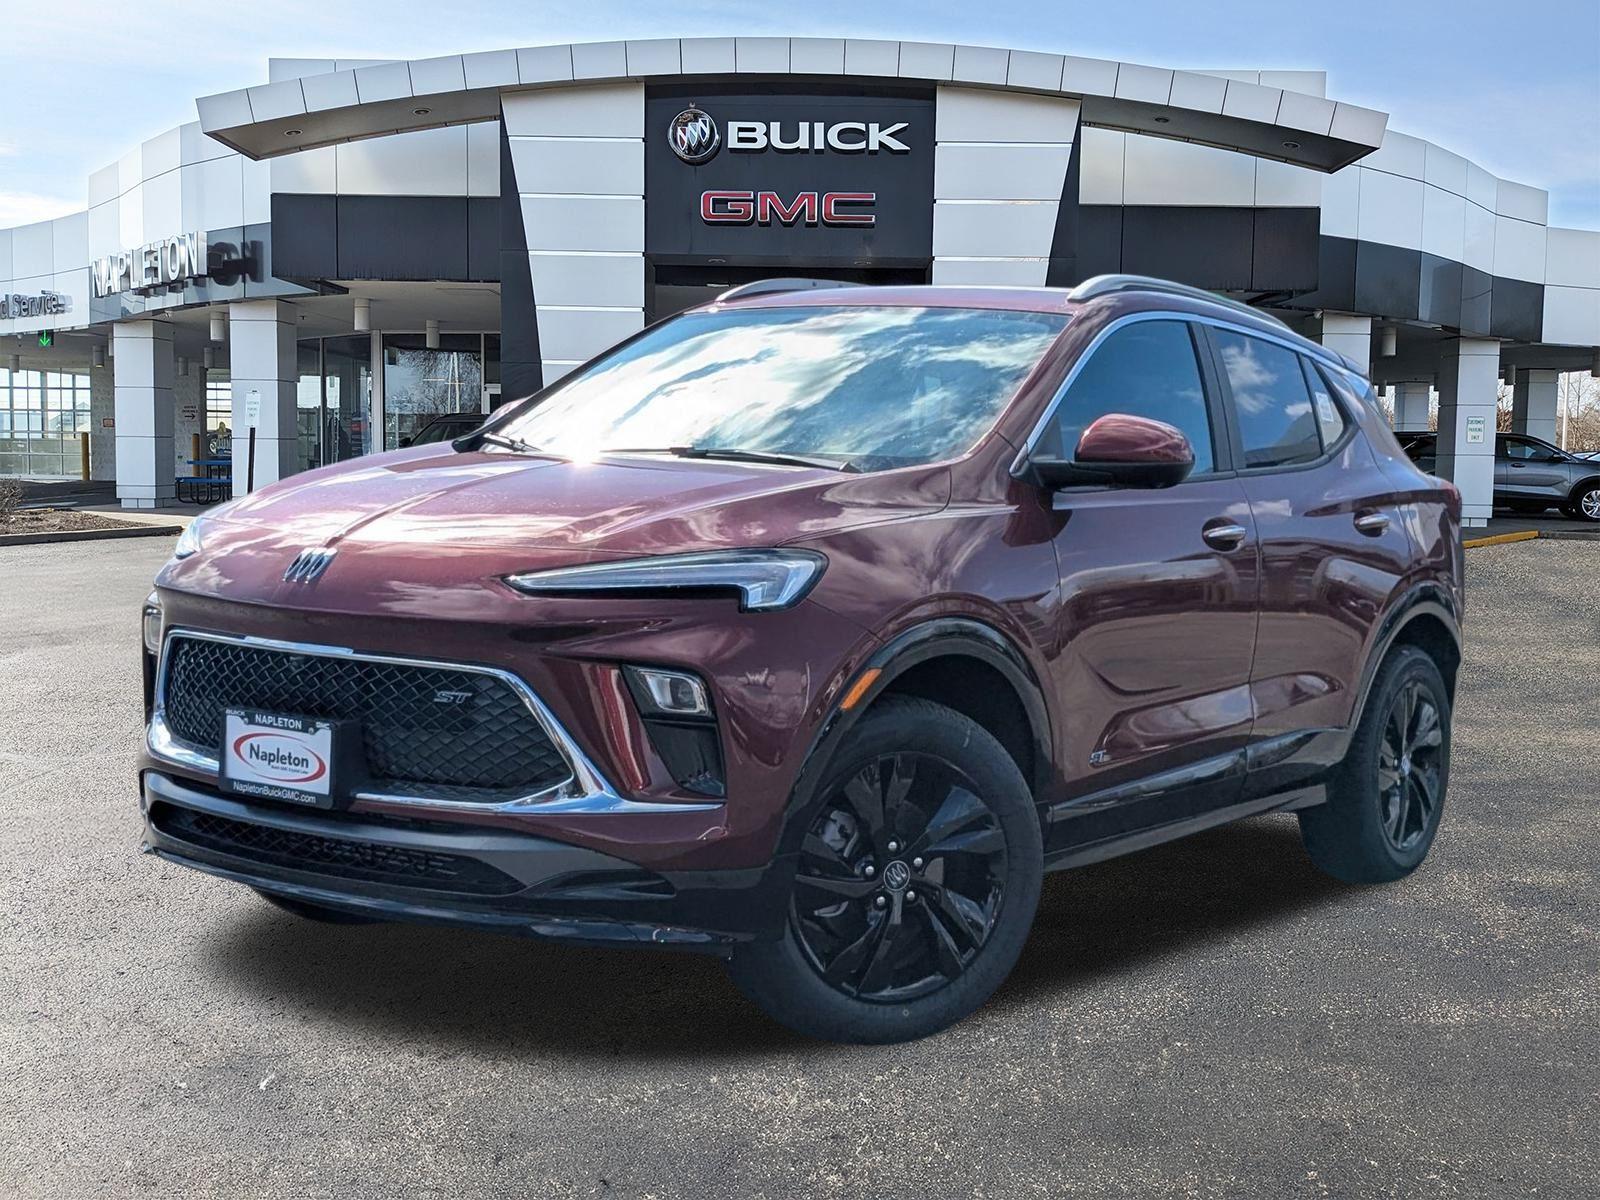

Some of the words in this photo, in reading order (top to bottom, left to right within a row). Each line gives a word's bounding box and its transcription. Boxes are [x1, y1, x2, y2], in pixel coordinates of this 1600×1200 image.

[727, 121, 911, 151] BUICK
[700, 190, 876, 223] GMC
[92, 231, 207, 298] NAPLETON
[13, 290, 65, 317] Service
[433, 691, 473, 704] ST
[255, 713, 302, 730] NAPLETON
[249, 743, 309, 769] Napleton
[233, 781, 316, 804] NapletonBuickGMC.com
